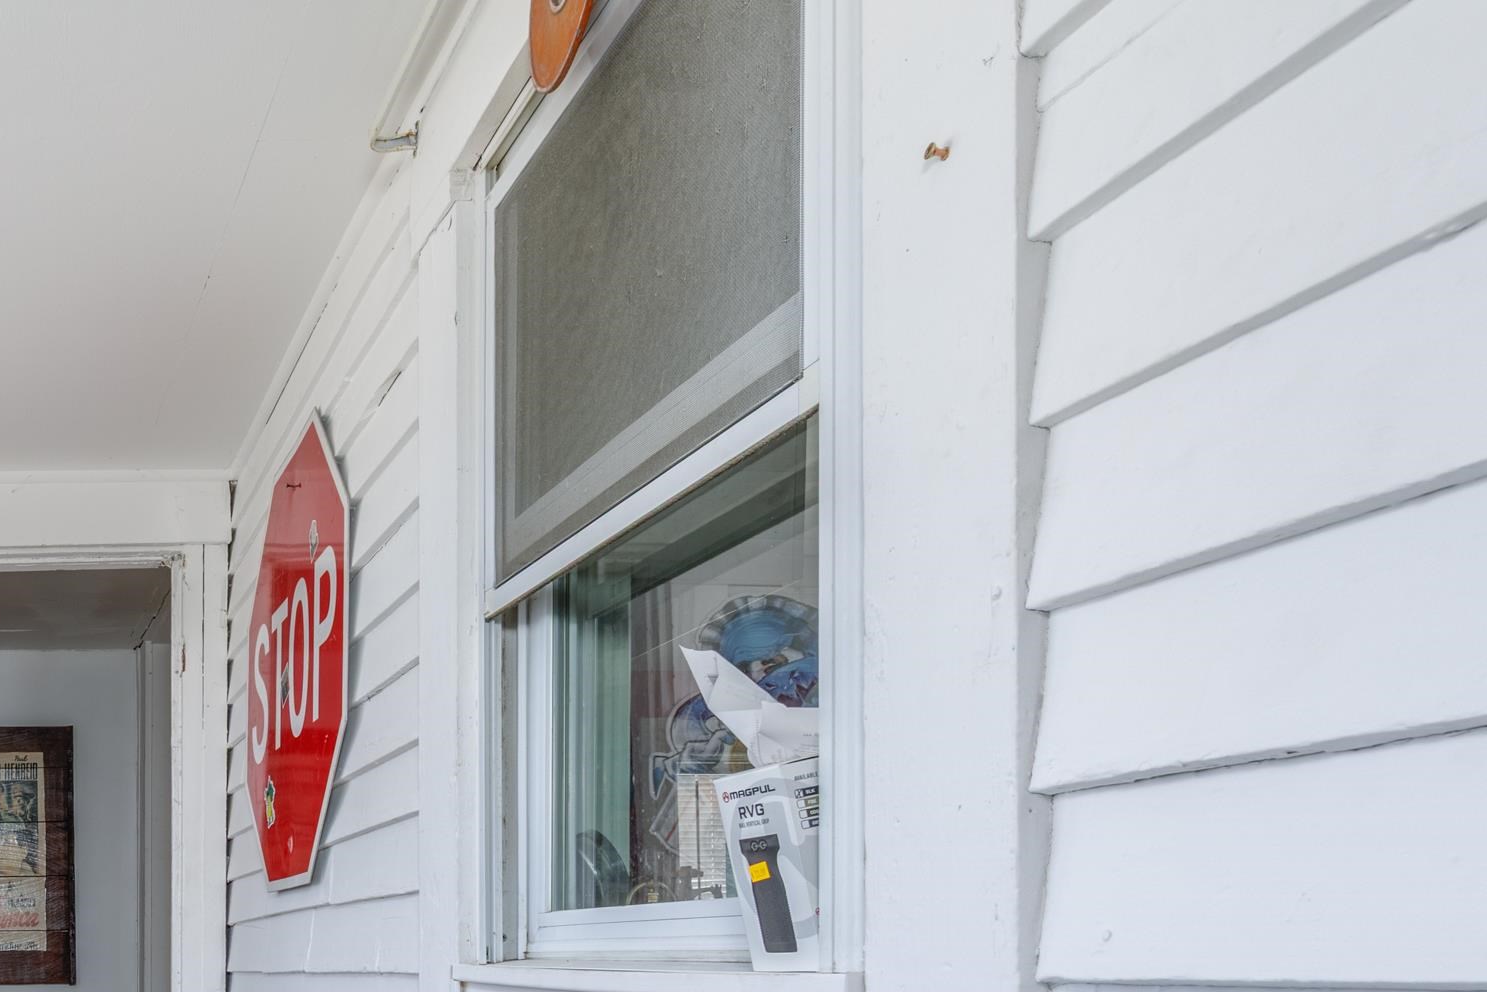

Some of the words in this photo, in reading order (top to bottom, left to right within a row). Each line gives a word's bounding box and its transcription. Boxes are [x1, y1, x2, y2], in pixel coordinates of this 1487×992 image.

[252, 544, 337, 766] STOP
[729, 784, 776, 800] MAGPUL
[738, 803, 765, 819] RVG
